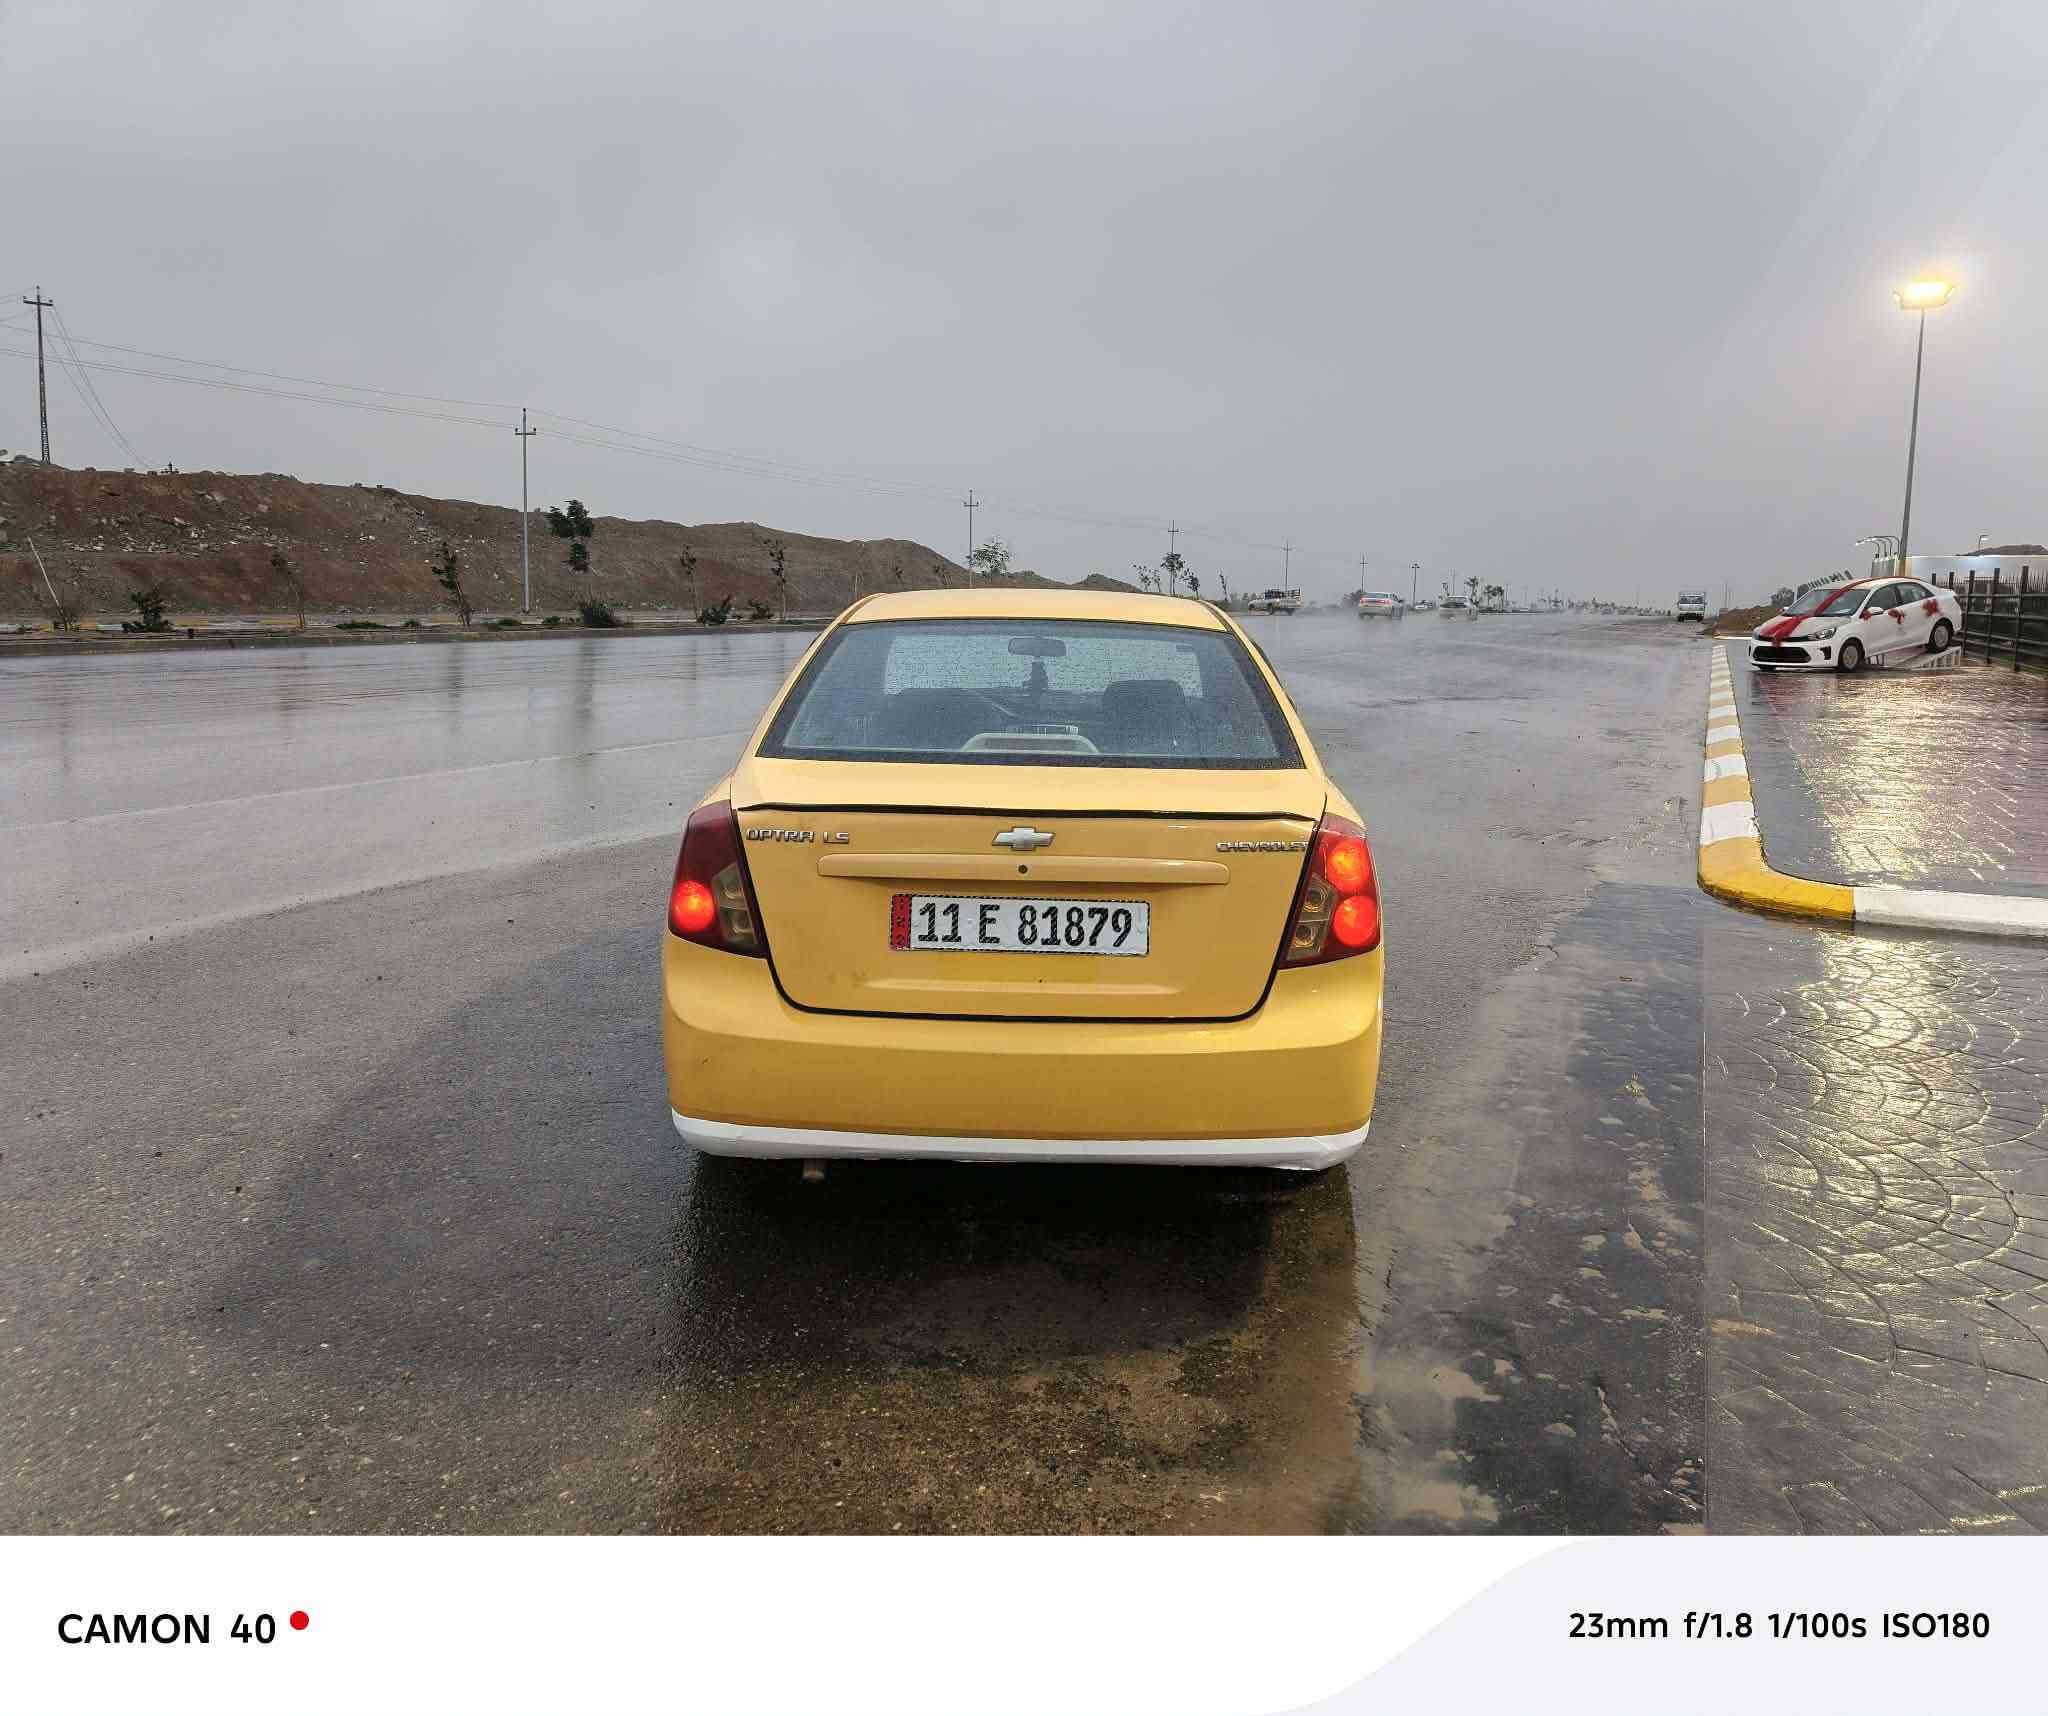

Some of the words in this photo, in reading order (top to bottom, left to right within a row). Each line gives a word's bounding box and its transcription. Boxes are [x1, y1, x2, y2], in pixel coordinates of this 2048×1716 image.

[746, 827, 815, 842] OPTRA
[823, 831, 849, 844] LS
[1216, 841, 1309, 853] CHEVROLET
[918, 902, 962, 944] 11
[978, 903, 1001, 944] E
[1017, 905, 1133, 949] 81879
